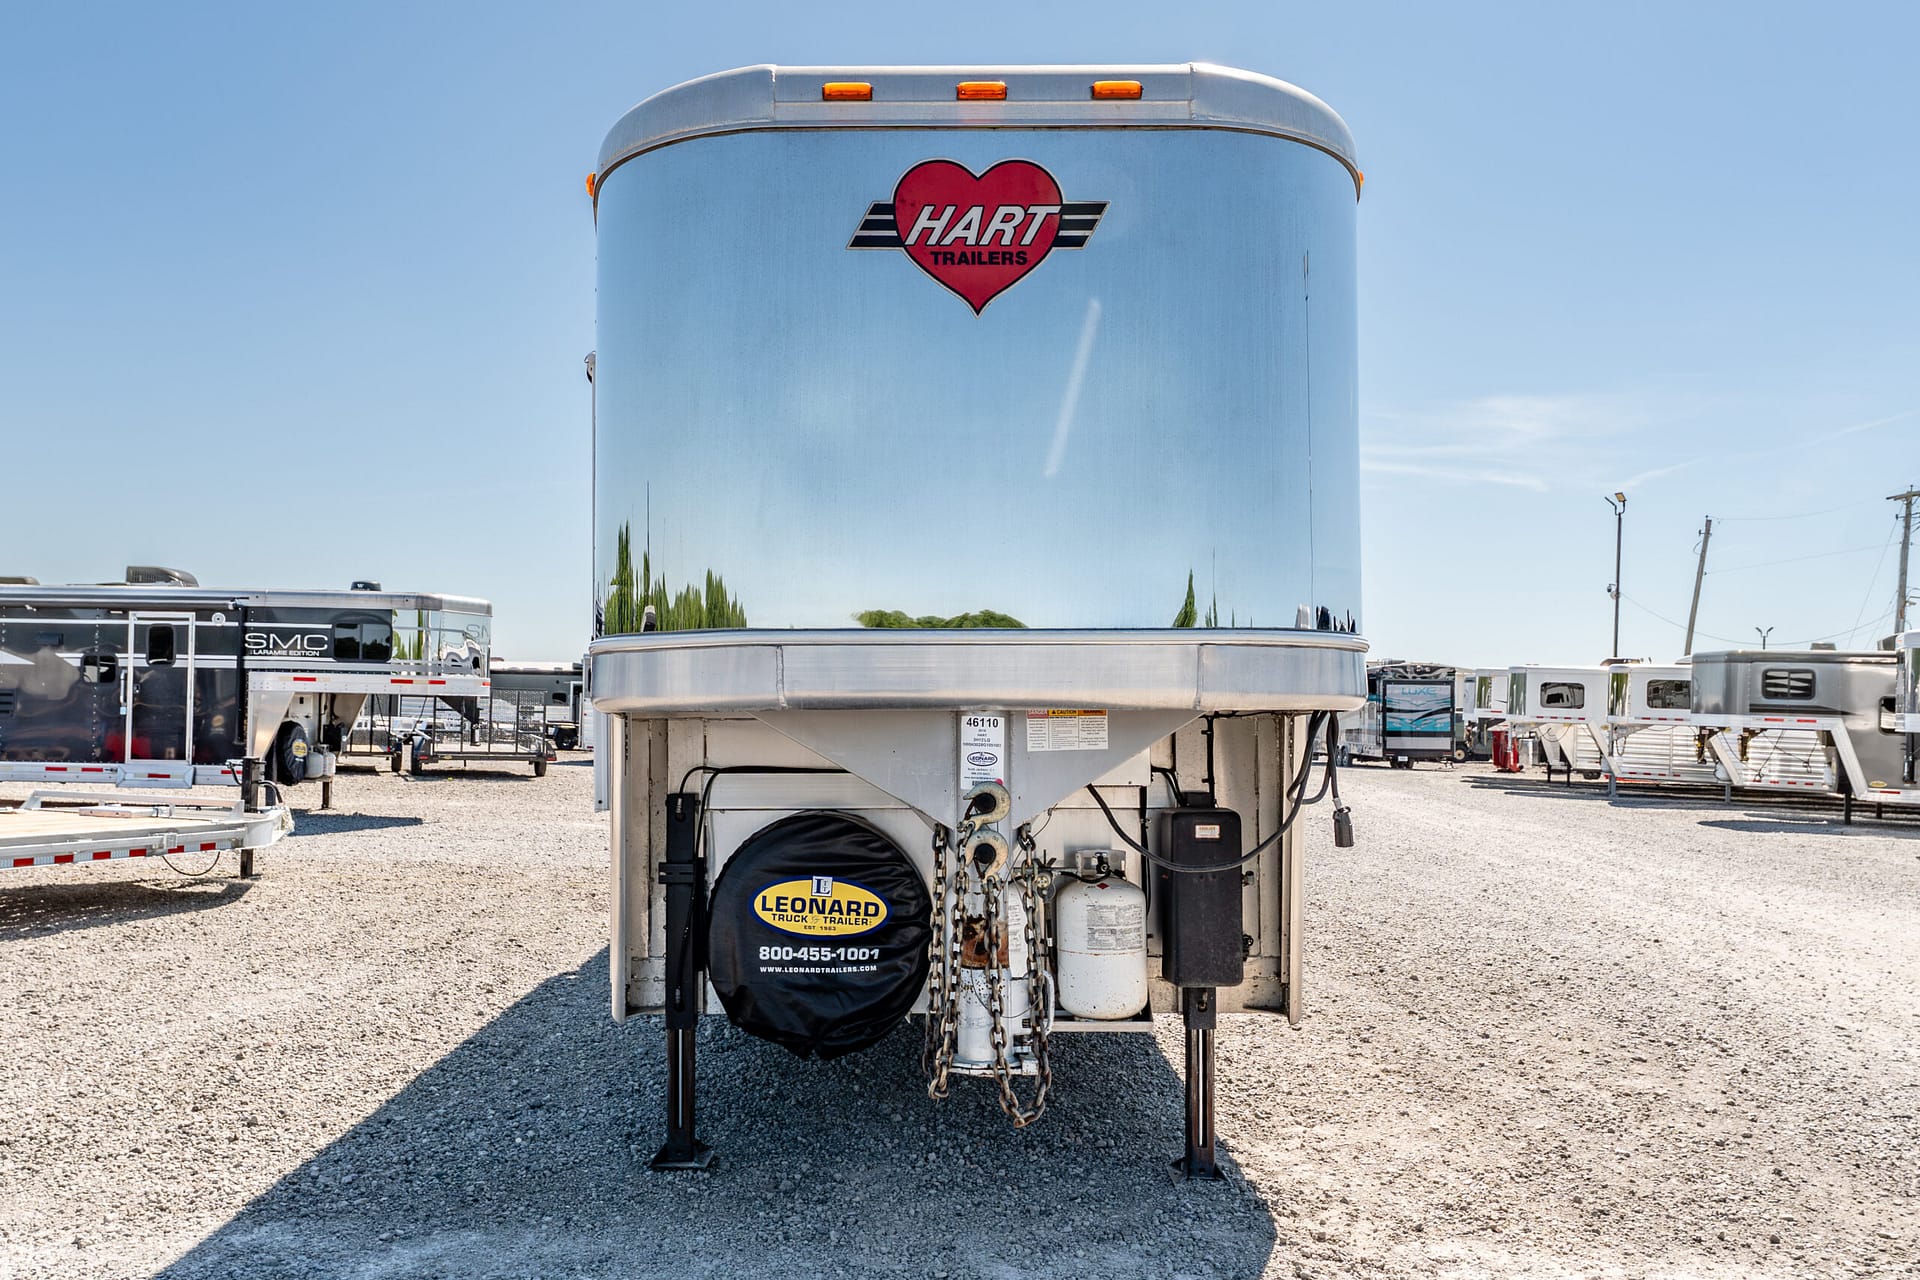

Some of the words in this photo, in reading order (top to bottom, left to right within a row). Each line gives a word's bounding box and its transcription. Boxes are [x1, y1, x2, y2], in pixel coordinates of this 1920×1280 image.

[903, 204, 1063, 247] HART
[930, 251, 1028, 266] TRAILERS
[244, 632, 329, 651] SMC
[1401, 687, 1437, 697] LUXE
[966, 717, 999, 728] 46110
[761, 895, 880, 917] LEONARD
[771, 913, 808, 923] TRUCK
[823, 916, 869, 926] TRAILER
[759, 946, 880, 961] 800-455-1001
[760, 965, 877, 974] WWW.LEONARDTRAILERS.COM
